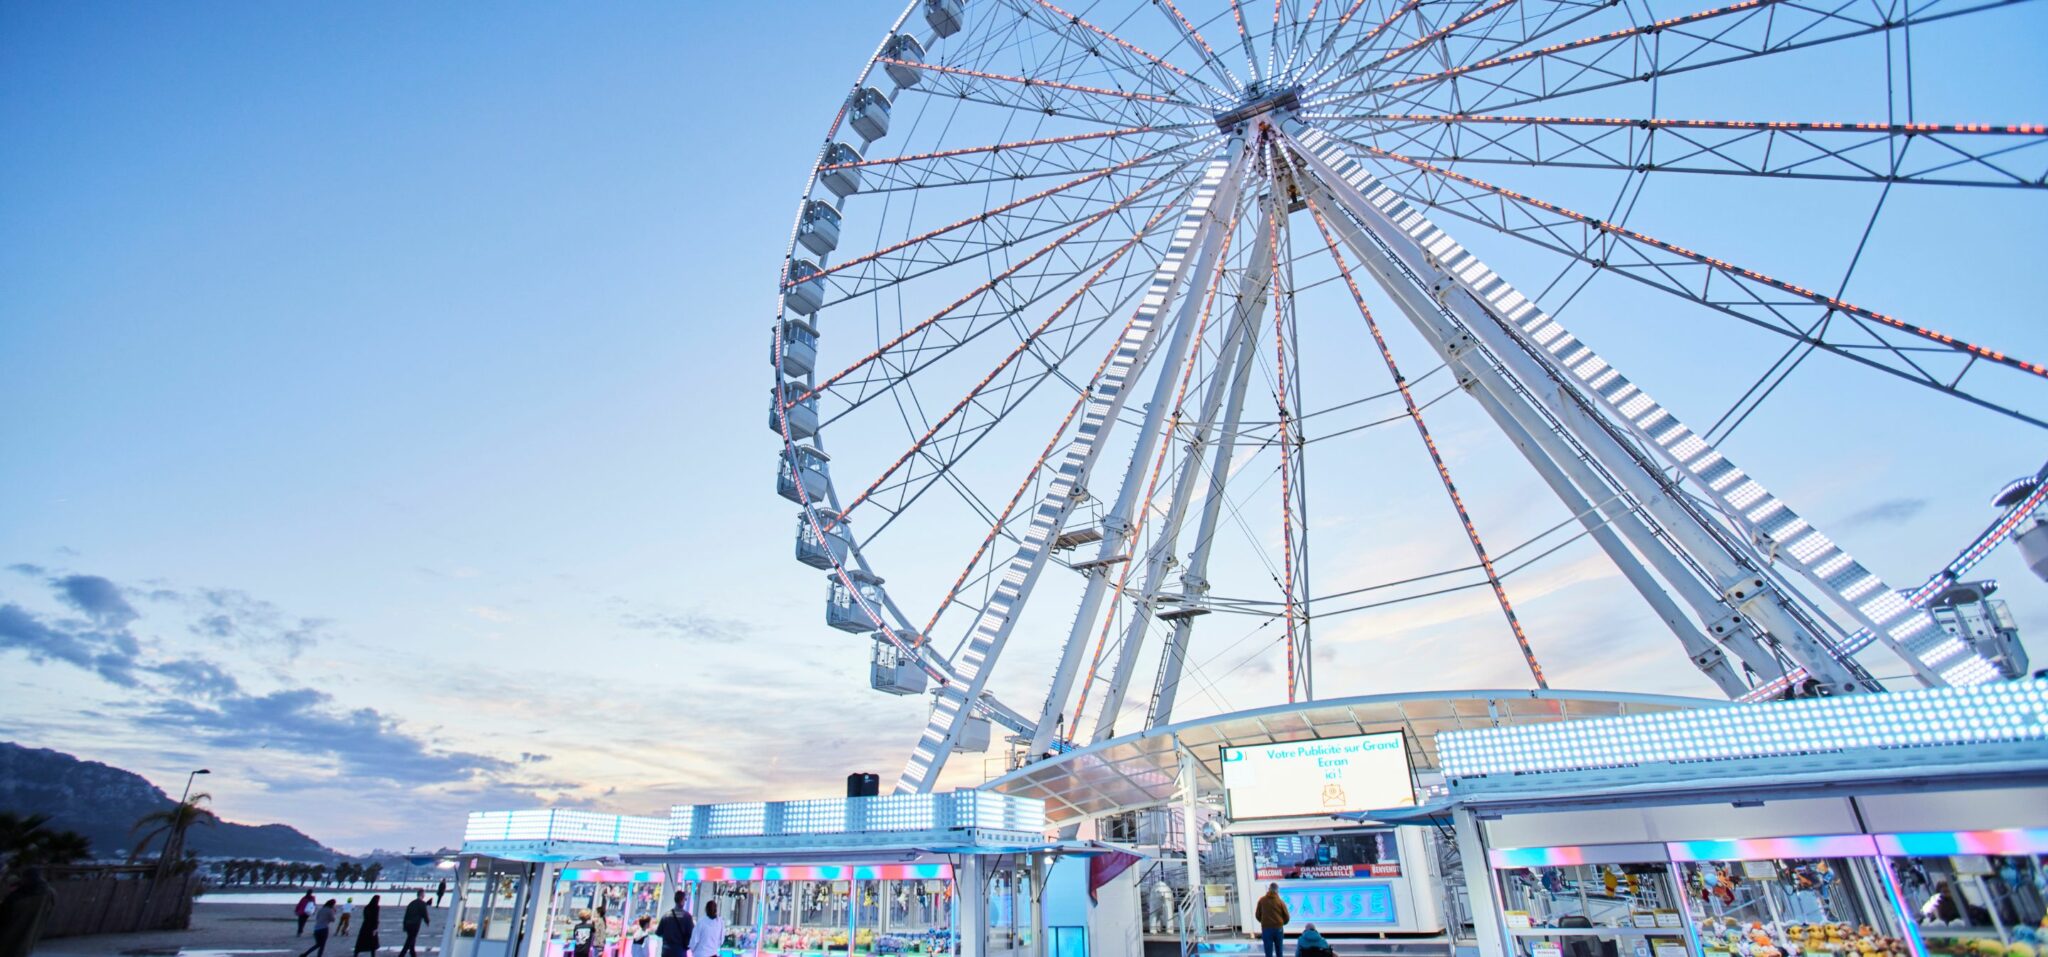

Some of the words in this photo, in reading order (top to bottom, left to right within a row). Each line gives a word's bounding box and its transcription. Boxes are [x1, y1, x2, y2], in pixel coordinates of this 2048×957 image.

[1266, 749, 1296, 760] Votre
[1297, 744, 1342, 758] Publicité
[1344, 745, 1360, 754] sur
[1362, 738, 1400, 752] Grand
[1317, 757, 1349, 768] Ecran
[1325, 768, 1337, 779] ici
[1257, 868, 1283, 877] WELCOME
[1312, 869, 1354, 878] MARSEILLE
